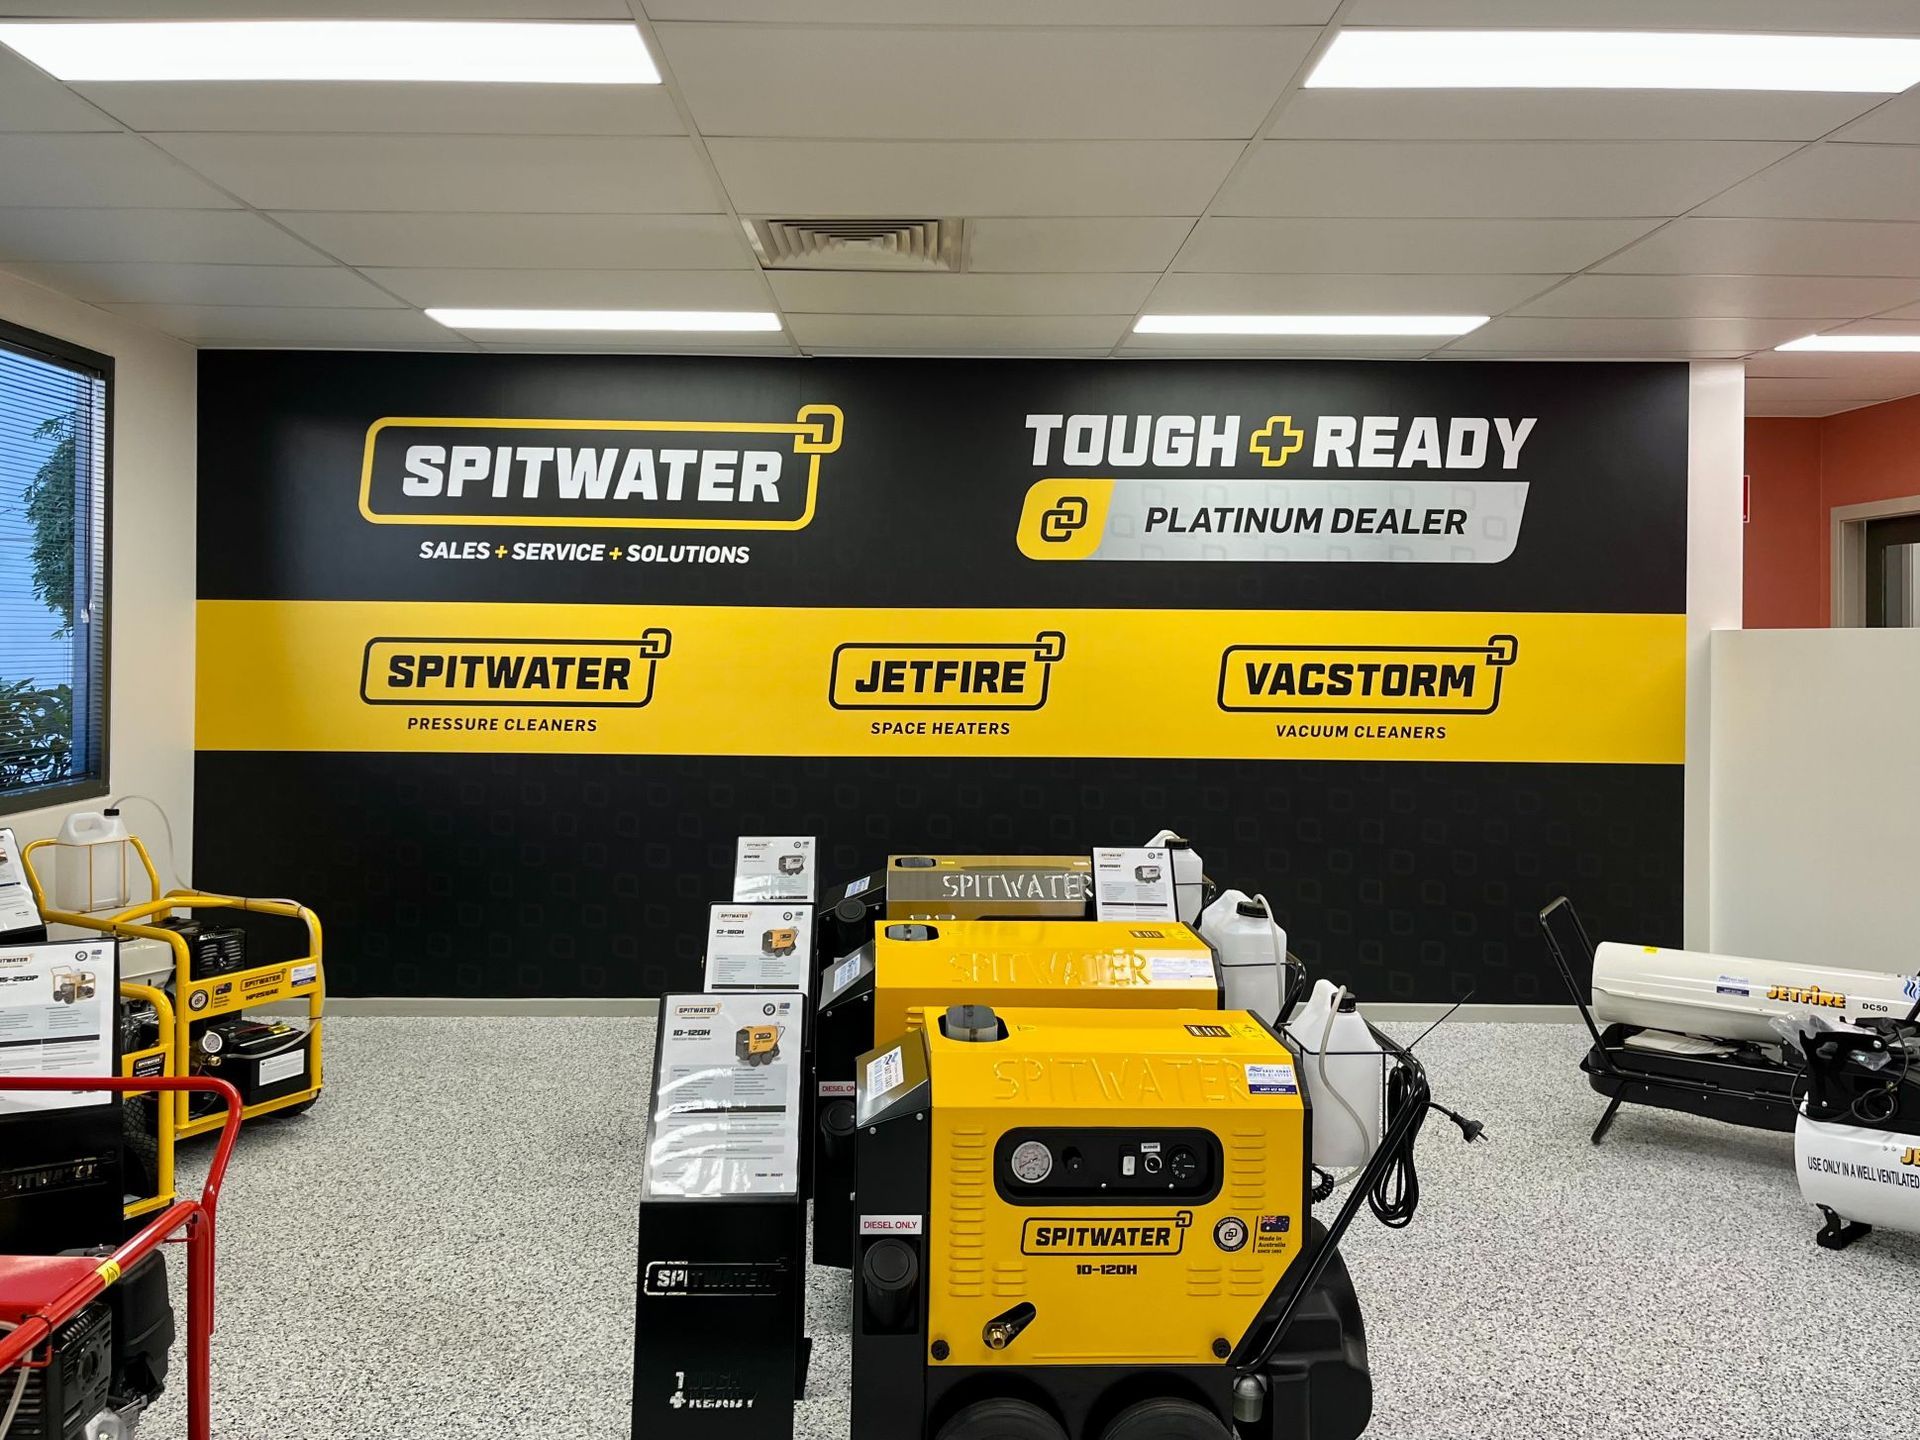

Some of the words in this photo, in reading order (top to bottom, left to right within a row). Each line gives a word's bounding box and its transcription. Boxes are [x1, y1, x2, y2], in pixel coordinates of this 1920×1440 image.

[1025, 414, 1240, 467] TOUGH
[1312, 416, 1537, 469] READY
[402, 445, 783, 503] SPITWATER
[1144, 507, 1327, 533] PLATINUM
[1330, 508, 1468, 535] DEALER
[419, 541, 490, 560] SALES
[511, 543, 605, 562] SERVICE
[626, 544, 751, 564] SOLUTIONS
[387, 655, 631, 690] SPITWATER
[855, 661, 1026, 693] JETFIRE
[1245, 663, 1475, 697] VACSTORM
[407, 717, 499, 731] PRESSURE
[504, 718, 597, 732] CLEANERS
[871, 722, 926, 734] SPACE
[932, 722, 1010, 735] HEATERS
[1276, 725, 1348, 738] VACUUM
[1354, 726, 1446, 739] CLEANERS
[942, 873, 1094, 899] SPITWATER
[1862, 1003, 1888, 1013] DC50
[993, 1057, 1249, 1103] SPITWATER
[1807, 1156, 1821, 1171] USE
[1823, 1159, 1840, 1176] ONLY
[1842, 1162, 1849, 1176] IN
[1850, 1163, 1856, 1178] A
[1856, 1164, 1876, 1181] WELL
[1876, 1168, 1920, 1189] VENTILATED
[864, 1221, 893, 1229] DIESEL
[895, 1221, 918, 1229] ONLY
[1035, 1227, 1171, 1247] SPITWATER
[1076, 1264, 1138, 1275] 10-120H
